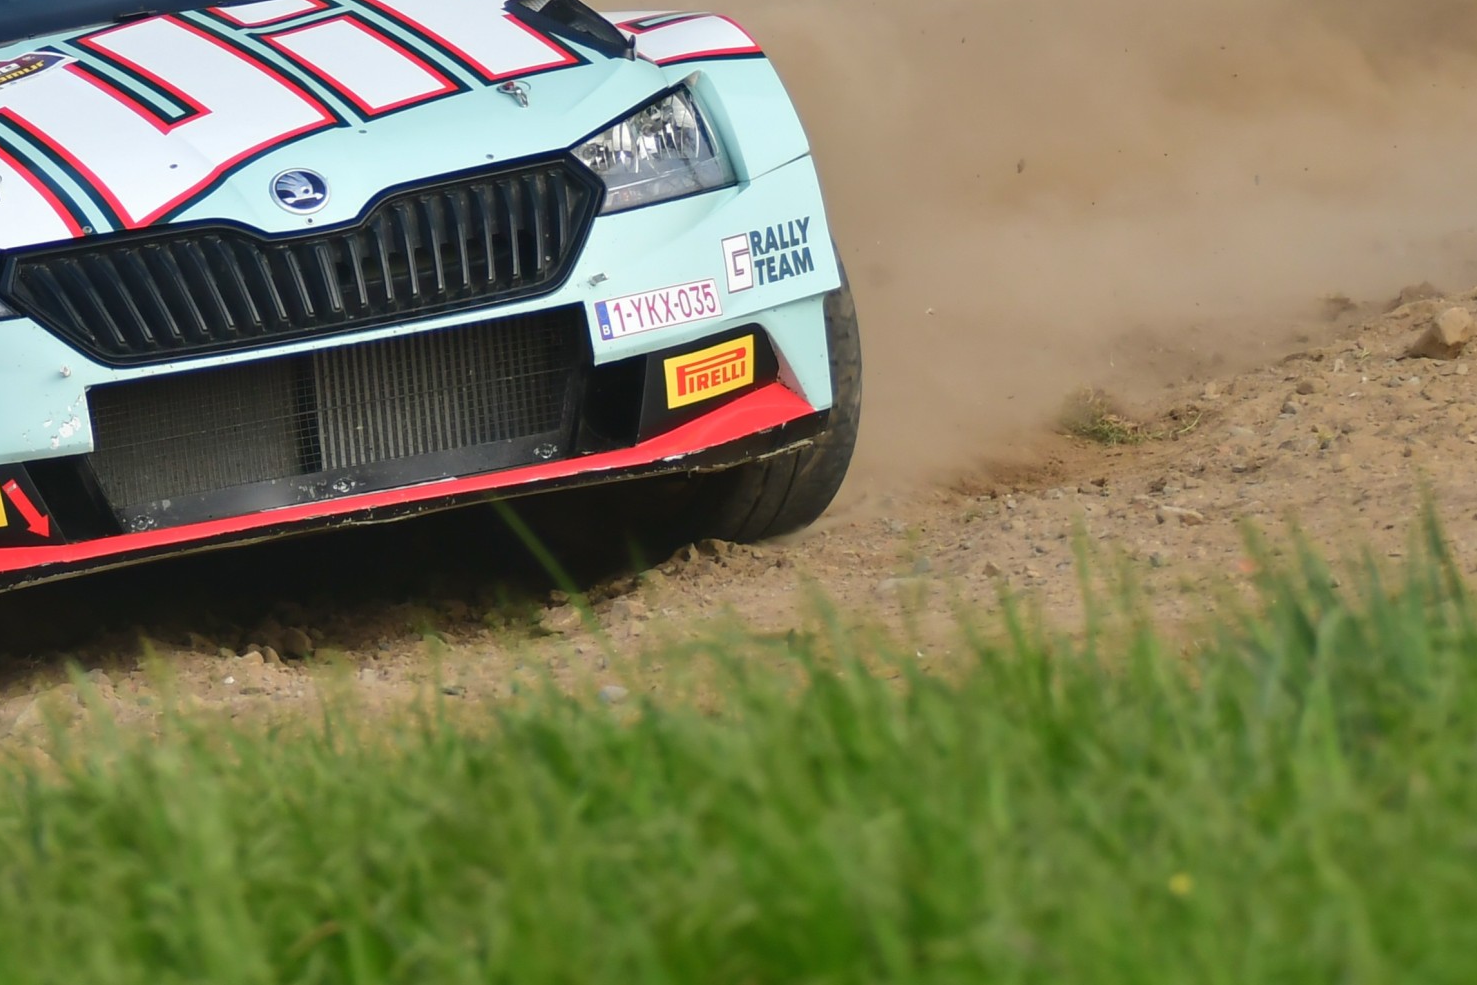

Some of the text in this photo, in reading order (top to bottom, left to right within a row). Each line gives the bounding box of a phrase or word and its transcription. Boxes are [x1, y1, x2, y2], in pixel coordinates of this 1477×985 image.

[749, 216, 810, 256] RALLY
[754, 246, 815, 286] TEAM
[602, 284, 717, 336] B 1-YKX-035
[676, 347, 746, 396] PIRELLI
